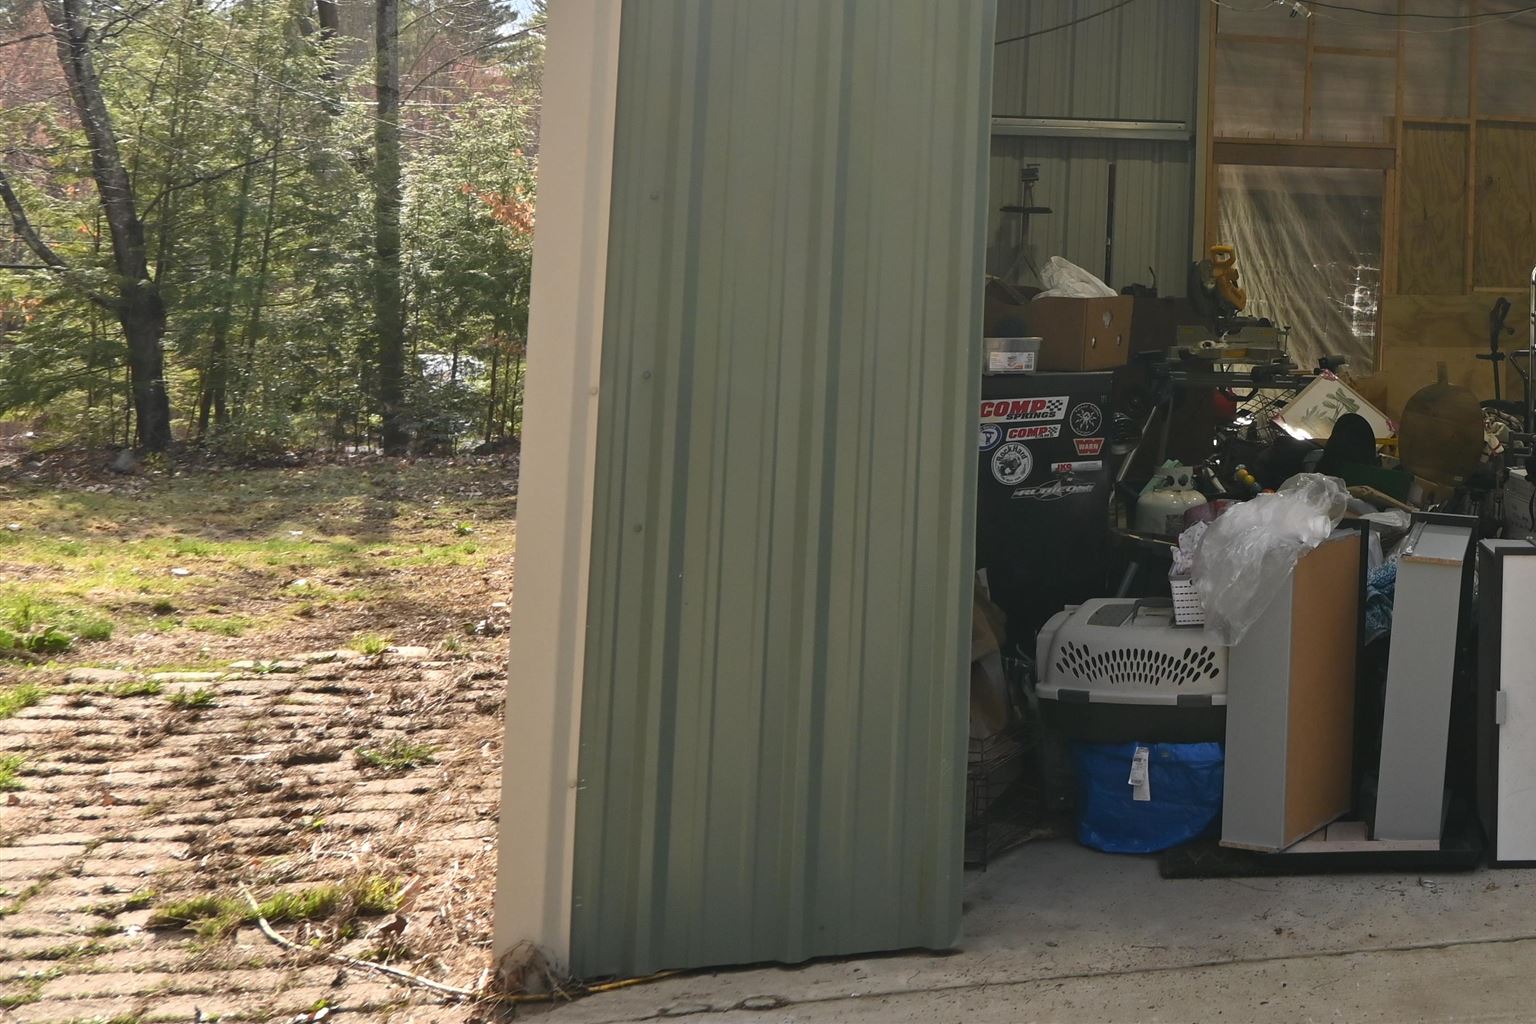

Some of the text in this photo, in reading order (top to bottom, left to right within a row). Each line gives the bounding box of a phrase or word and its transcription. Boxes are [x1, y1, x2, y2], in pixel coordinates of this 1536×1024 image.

[981, 400, 1047, 418] COMP
[1006, 411, 1057, 421] SPRINGS
[1008, 427, 1049, 439] COMP
